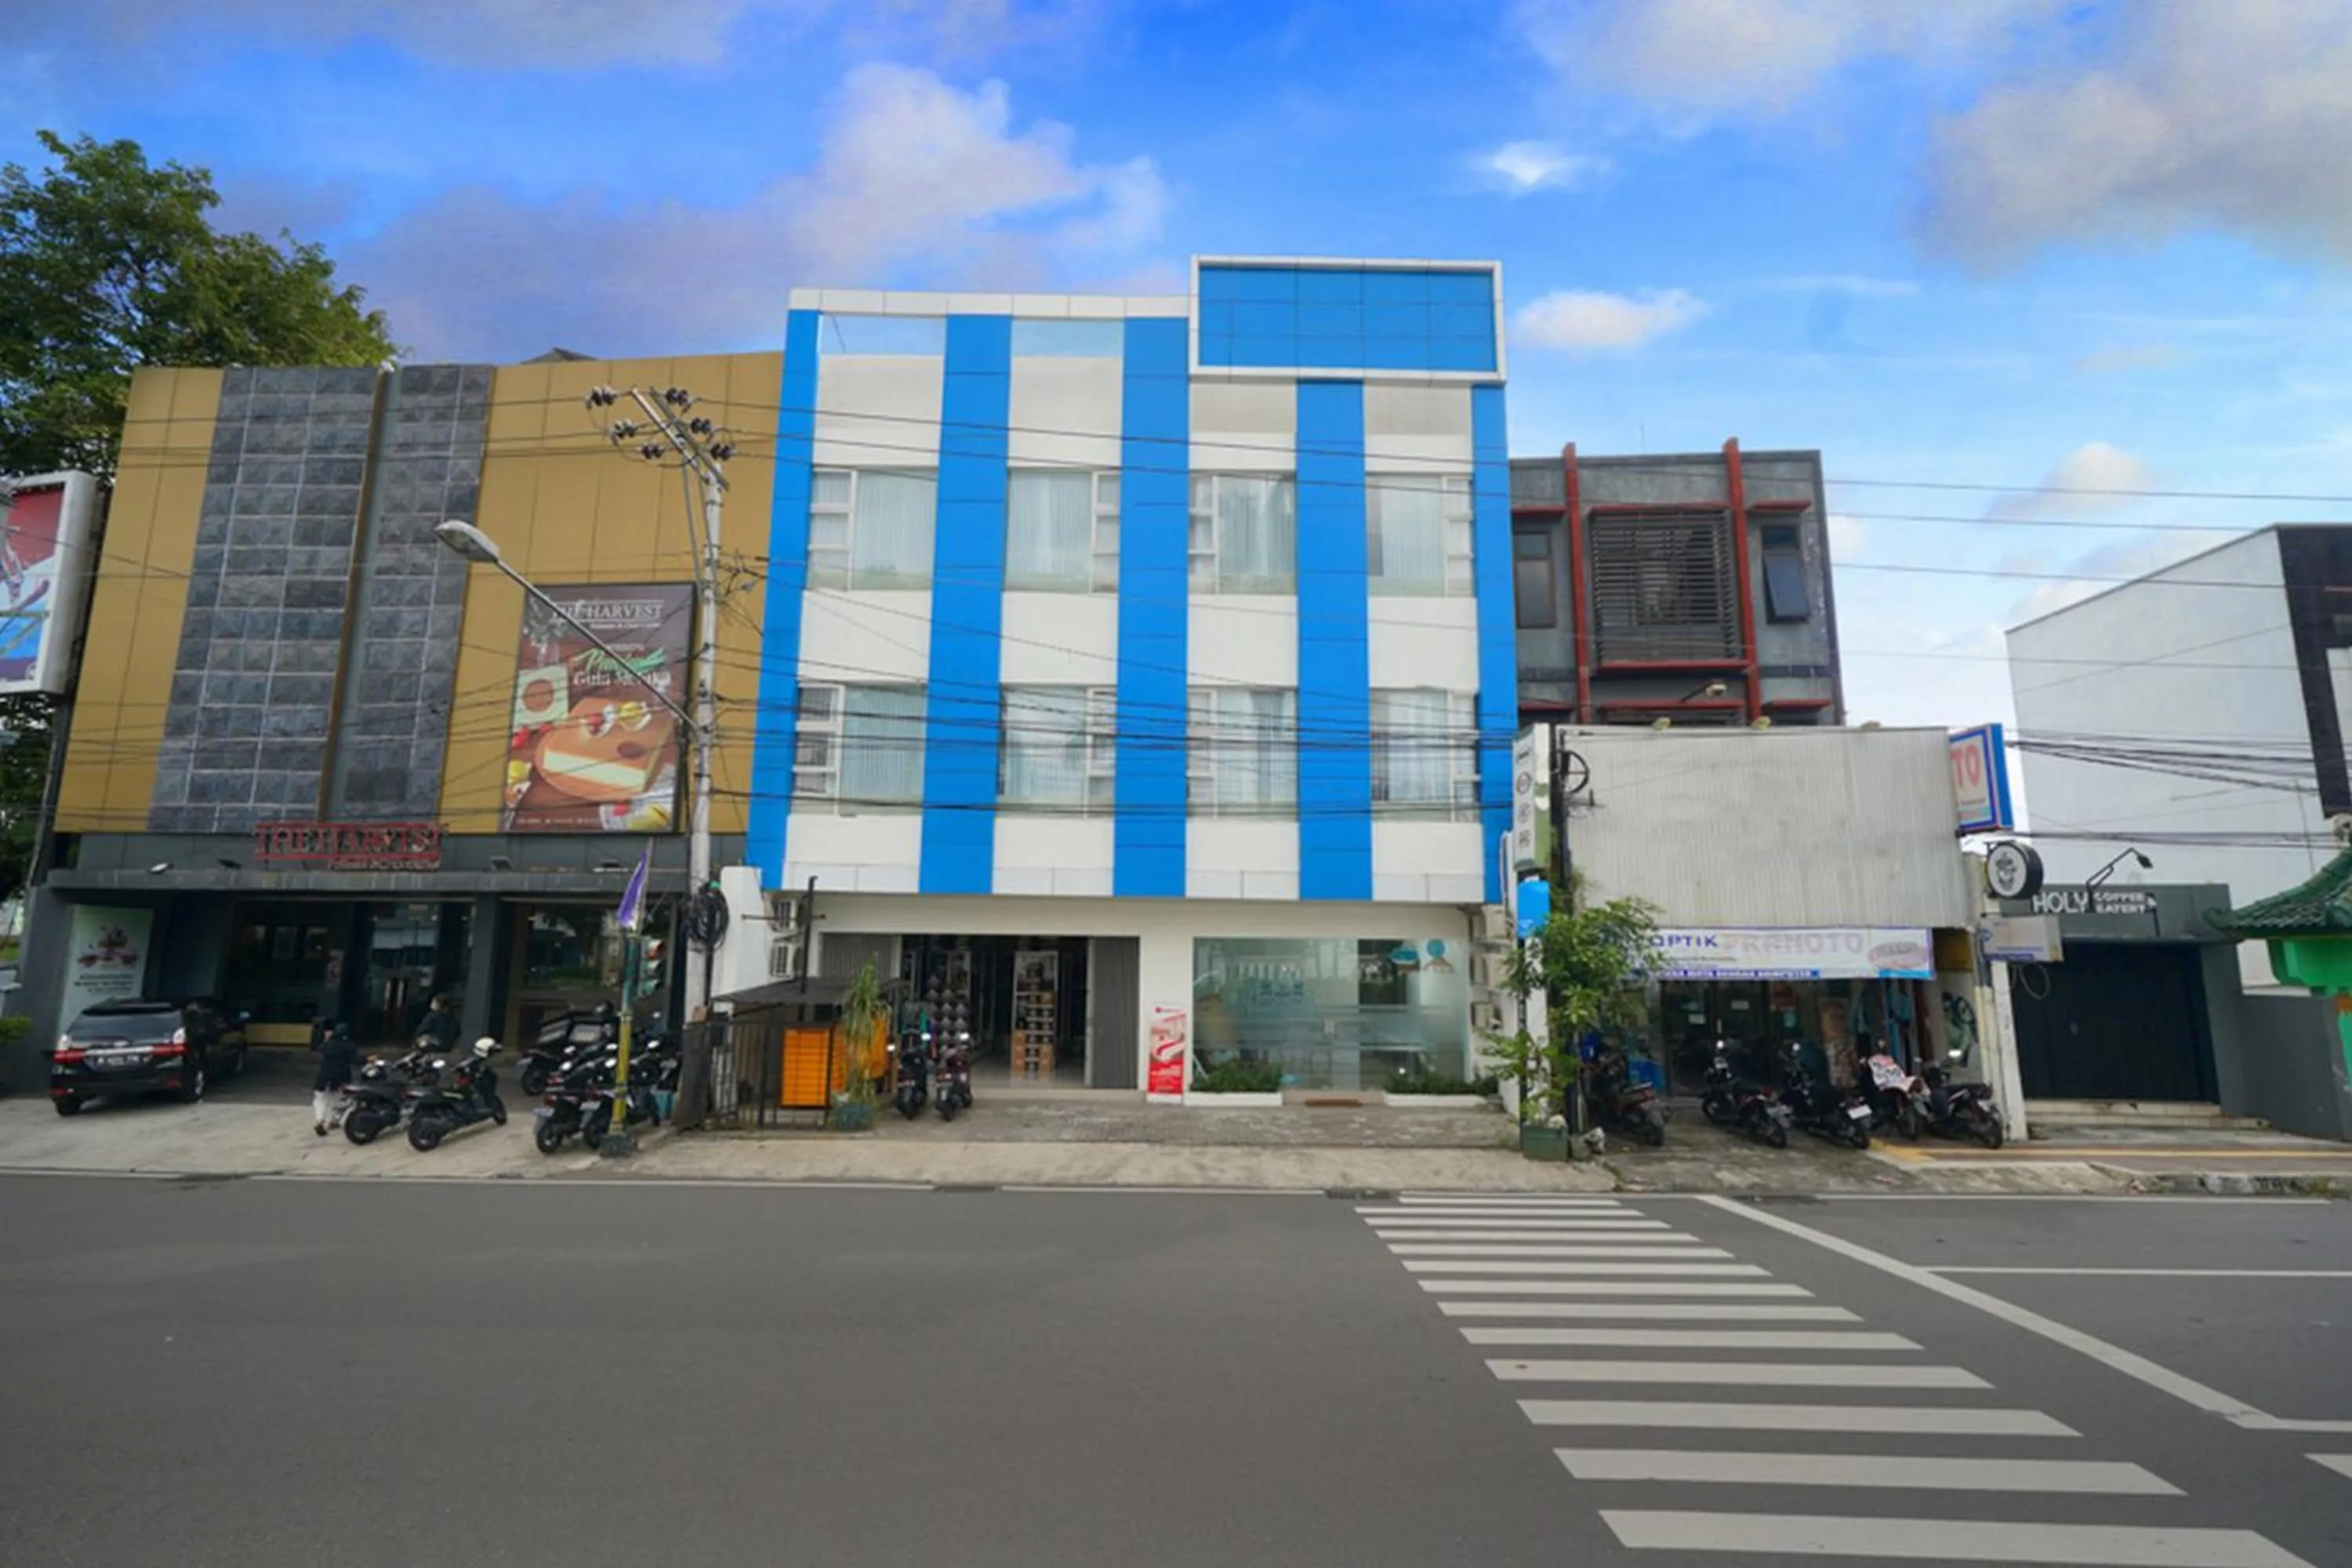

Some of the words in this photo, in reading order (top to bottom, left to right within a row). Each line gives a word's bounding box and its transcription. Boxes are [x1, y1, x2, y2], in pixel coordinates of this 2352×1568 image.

[587, 603, 665, 619] HARVEST
[2032, 891, 2089, 913] HOLY
[1649, 934, 1719, 948] OPTIK
